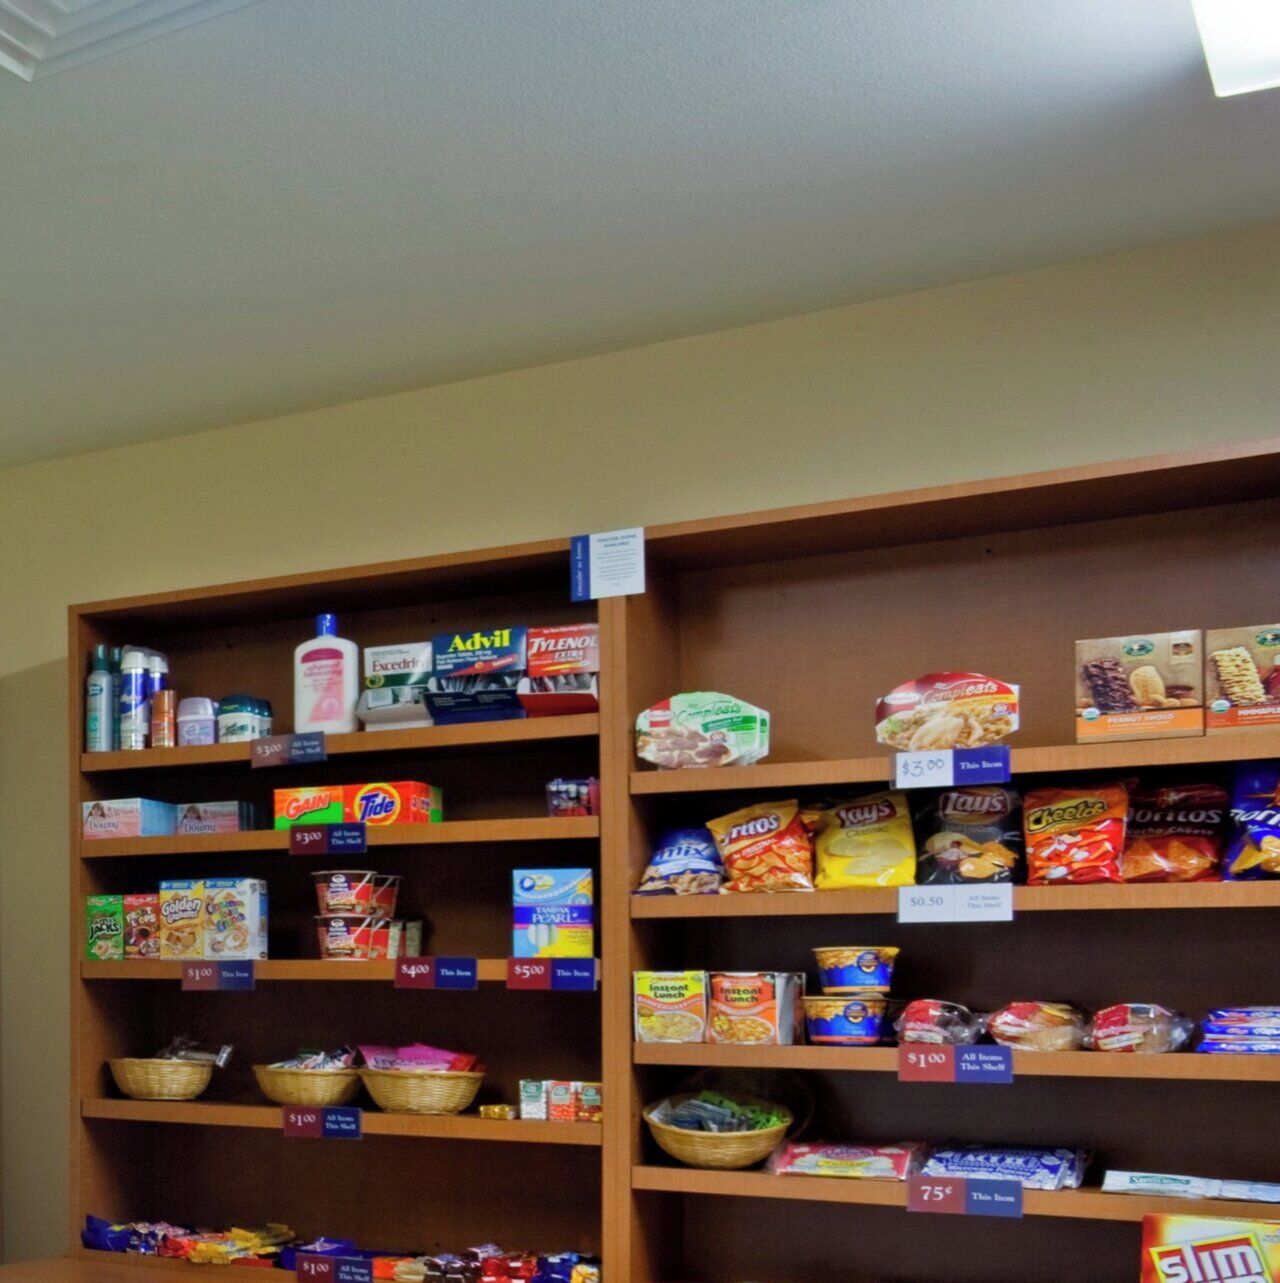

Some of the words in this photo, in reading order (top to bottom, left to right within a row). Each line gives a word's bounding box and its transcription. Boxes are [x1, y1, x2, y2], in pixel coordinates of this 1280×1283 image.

[447, 629, 511, 653] Advil
[529, 634, 599, 654] TYLENOL
[372, 657, 425, 673] Excedrin
[921, 678, 998, 704] Compleats
[959, 760, 980, 770] This
[981, 760, 1003, 770] Item
[284, 792, 330, 820] GAIN
[357, 794, 395, 823] Tide
[943, 792, 1005, 815] Lay's
[1027, 800, 1108, 833] Cheetos
[89, 819, 120, 832] Downy
[183, 822, 216, 834] Downy
[161, 896, 202, 916] Golden
[910, 896, 944, 907] $0.50
[535, 906, 570, 914] TAMPAX
[532, 914, 572, 923] PEARL
[89, 921, 121, 942] JACKS
[440, 968, 455, 976] This
[456, 968, 472, 977] Item
[556, 968, 572, 977] This
[573, 969, 591, 978] Item
[649, 983, 689, 993] Instant
[653, 991, 686, 1000] Lunch
[962, 1053, 975, 1062] All
[977, 1053, 1003, 1062] Items
[959, 1062, 981, 1072] This
[982, 1062, 1006, 1073] Shelf
[920, 1185, 953, 1201] 75¢
[970, 1192, 991, 1201] This
[993, 1193, 1016, 1203] Item
